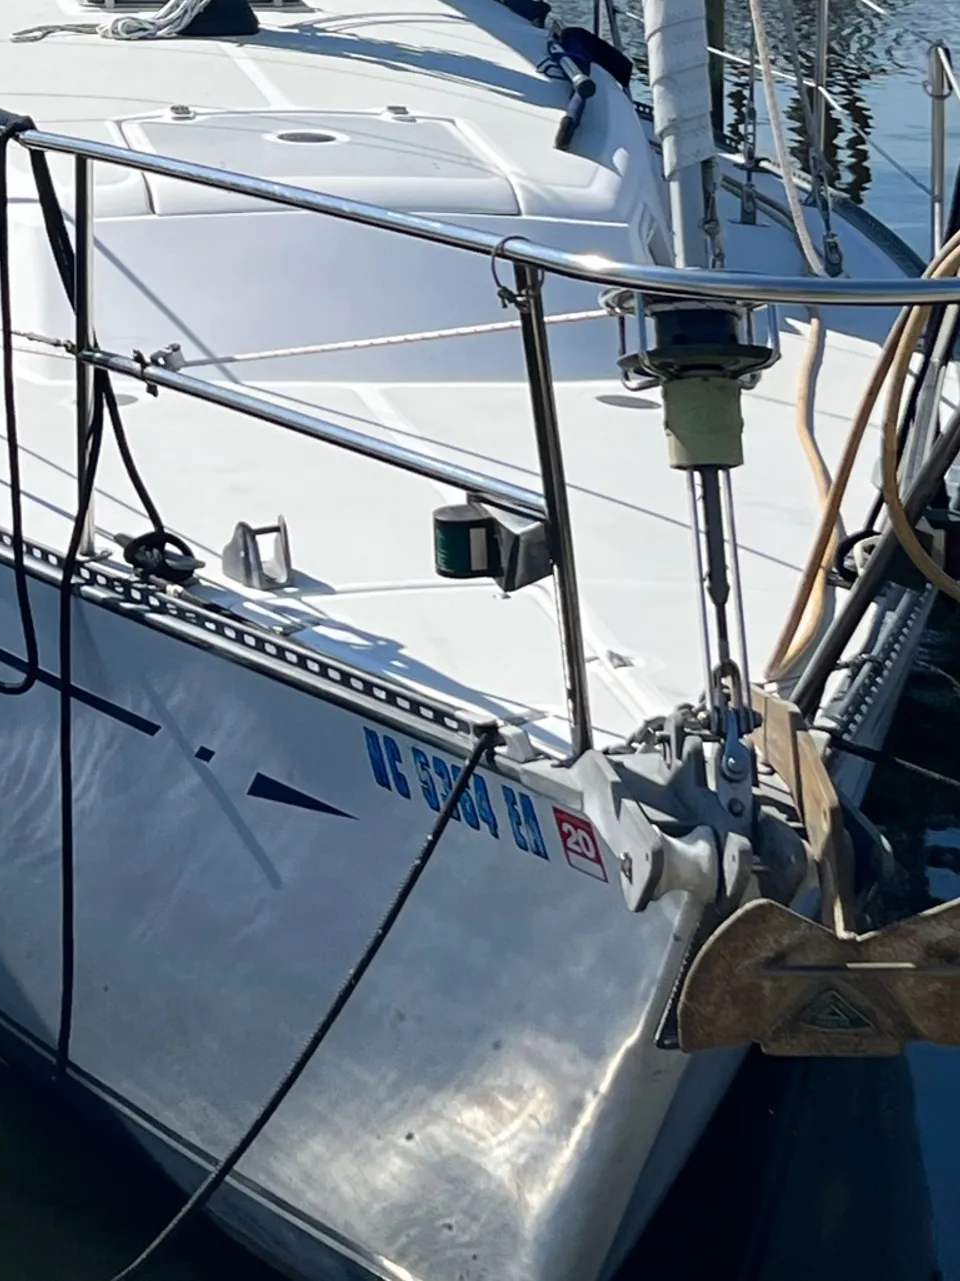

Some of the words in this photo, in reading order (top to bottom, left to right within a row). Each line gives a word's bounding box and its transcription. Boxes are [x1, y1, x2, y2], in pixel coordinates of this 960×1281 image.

[363, 725, 411, 800] NC
[501, 783, 550, 862] EA
[561, 822, 598, 860] 20
